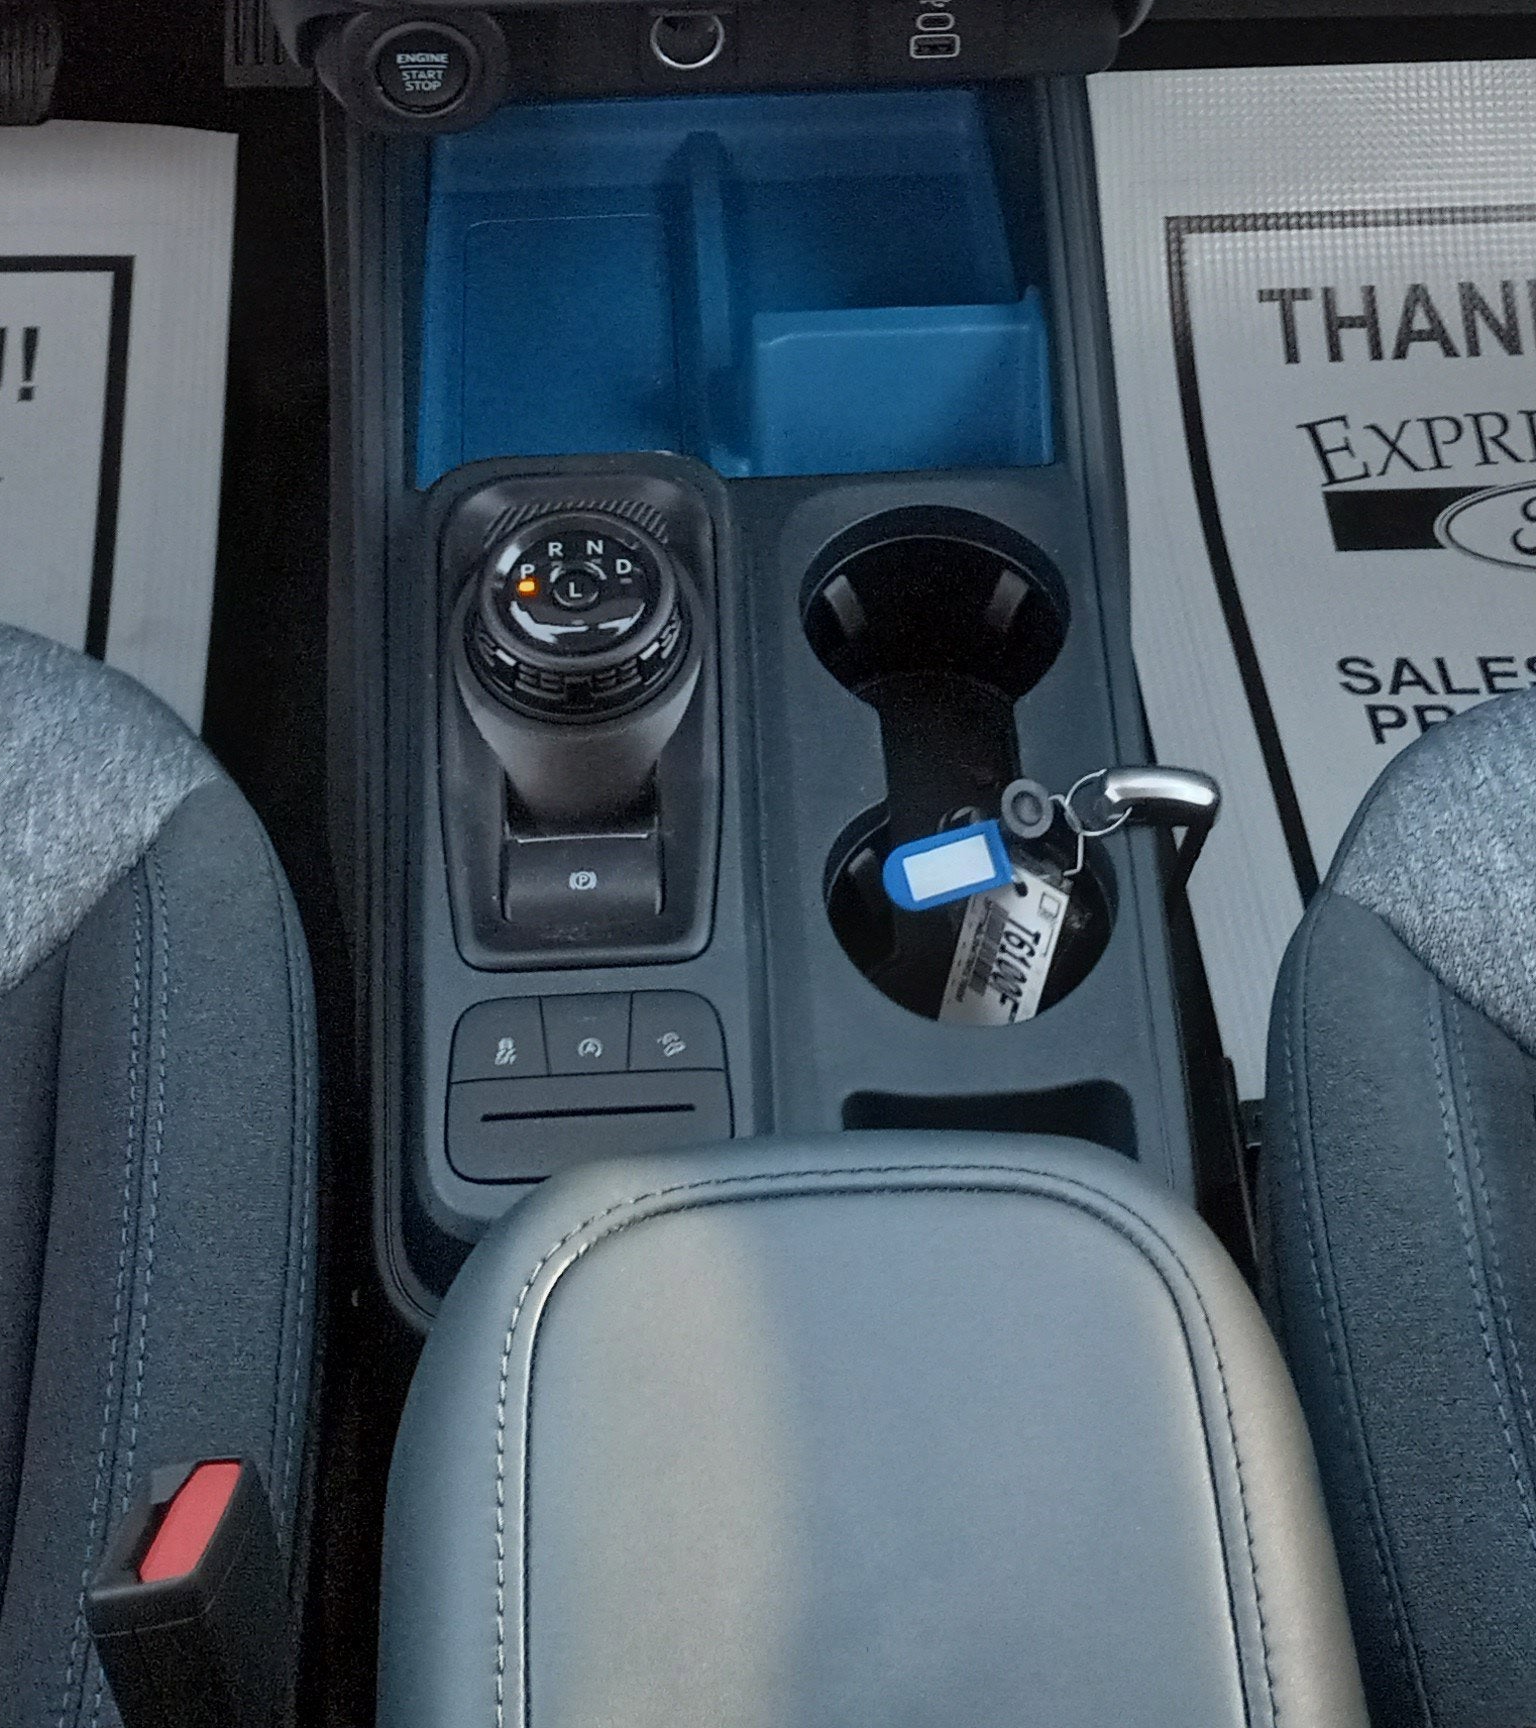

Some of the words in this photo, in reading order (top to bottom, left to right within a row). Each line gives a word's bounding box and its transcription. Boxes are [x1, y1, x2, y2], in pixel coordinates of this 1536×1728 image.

[396, 52, 449, 64] ENGINE
[402, 70, 443, 80] START
[405, 80, 441, 91] STOP
[548, 541, 564, 557] R
[586, 539, 604, 555] N
[520, 563, 535, 579] P
[616, 558, 632, 574] D
[568, 581, 582, 598] L
[990, 917, 1041, 1022] T6100F
